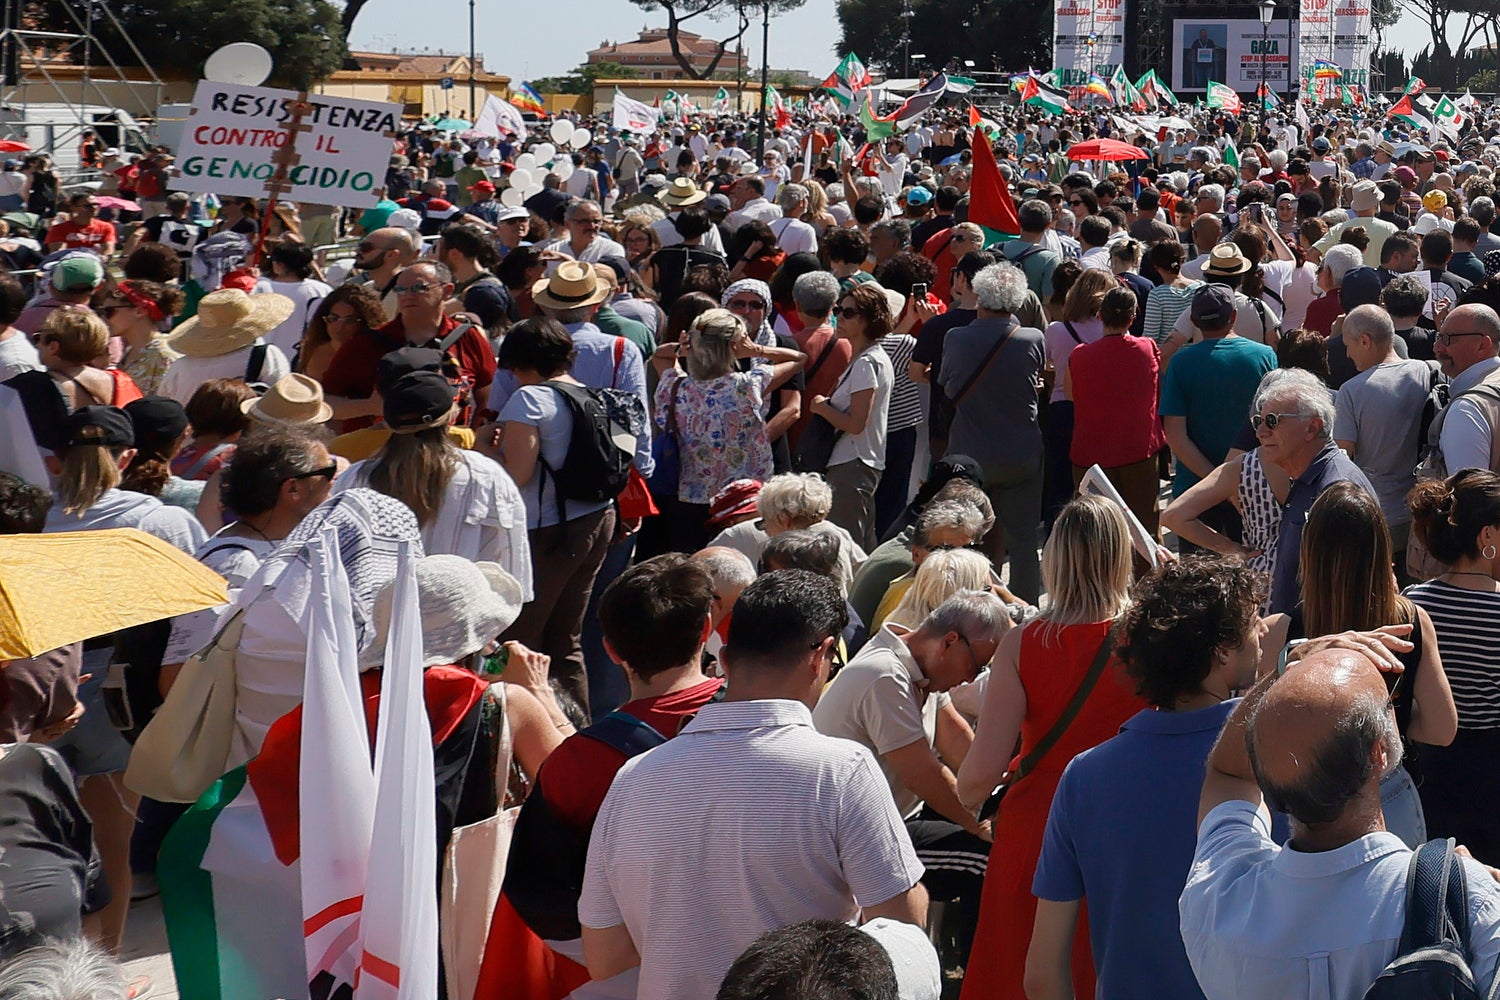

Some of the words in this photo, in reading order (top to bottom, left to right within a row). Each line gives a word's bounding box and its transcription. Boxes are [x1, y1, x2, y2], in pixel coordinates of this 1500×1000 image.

[1250, 40, 1279, 54] GAZA
[212, 92, 395, 133] RESISTENZA
[194, 125, 290, 148] CONTRO
[315, 135, 340, 154] IL
[182, 156, 373, 192] GENOCIDIO
